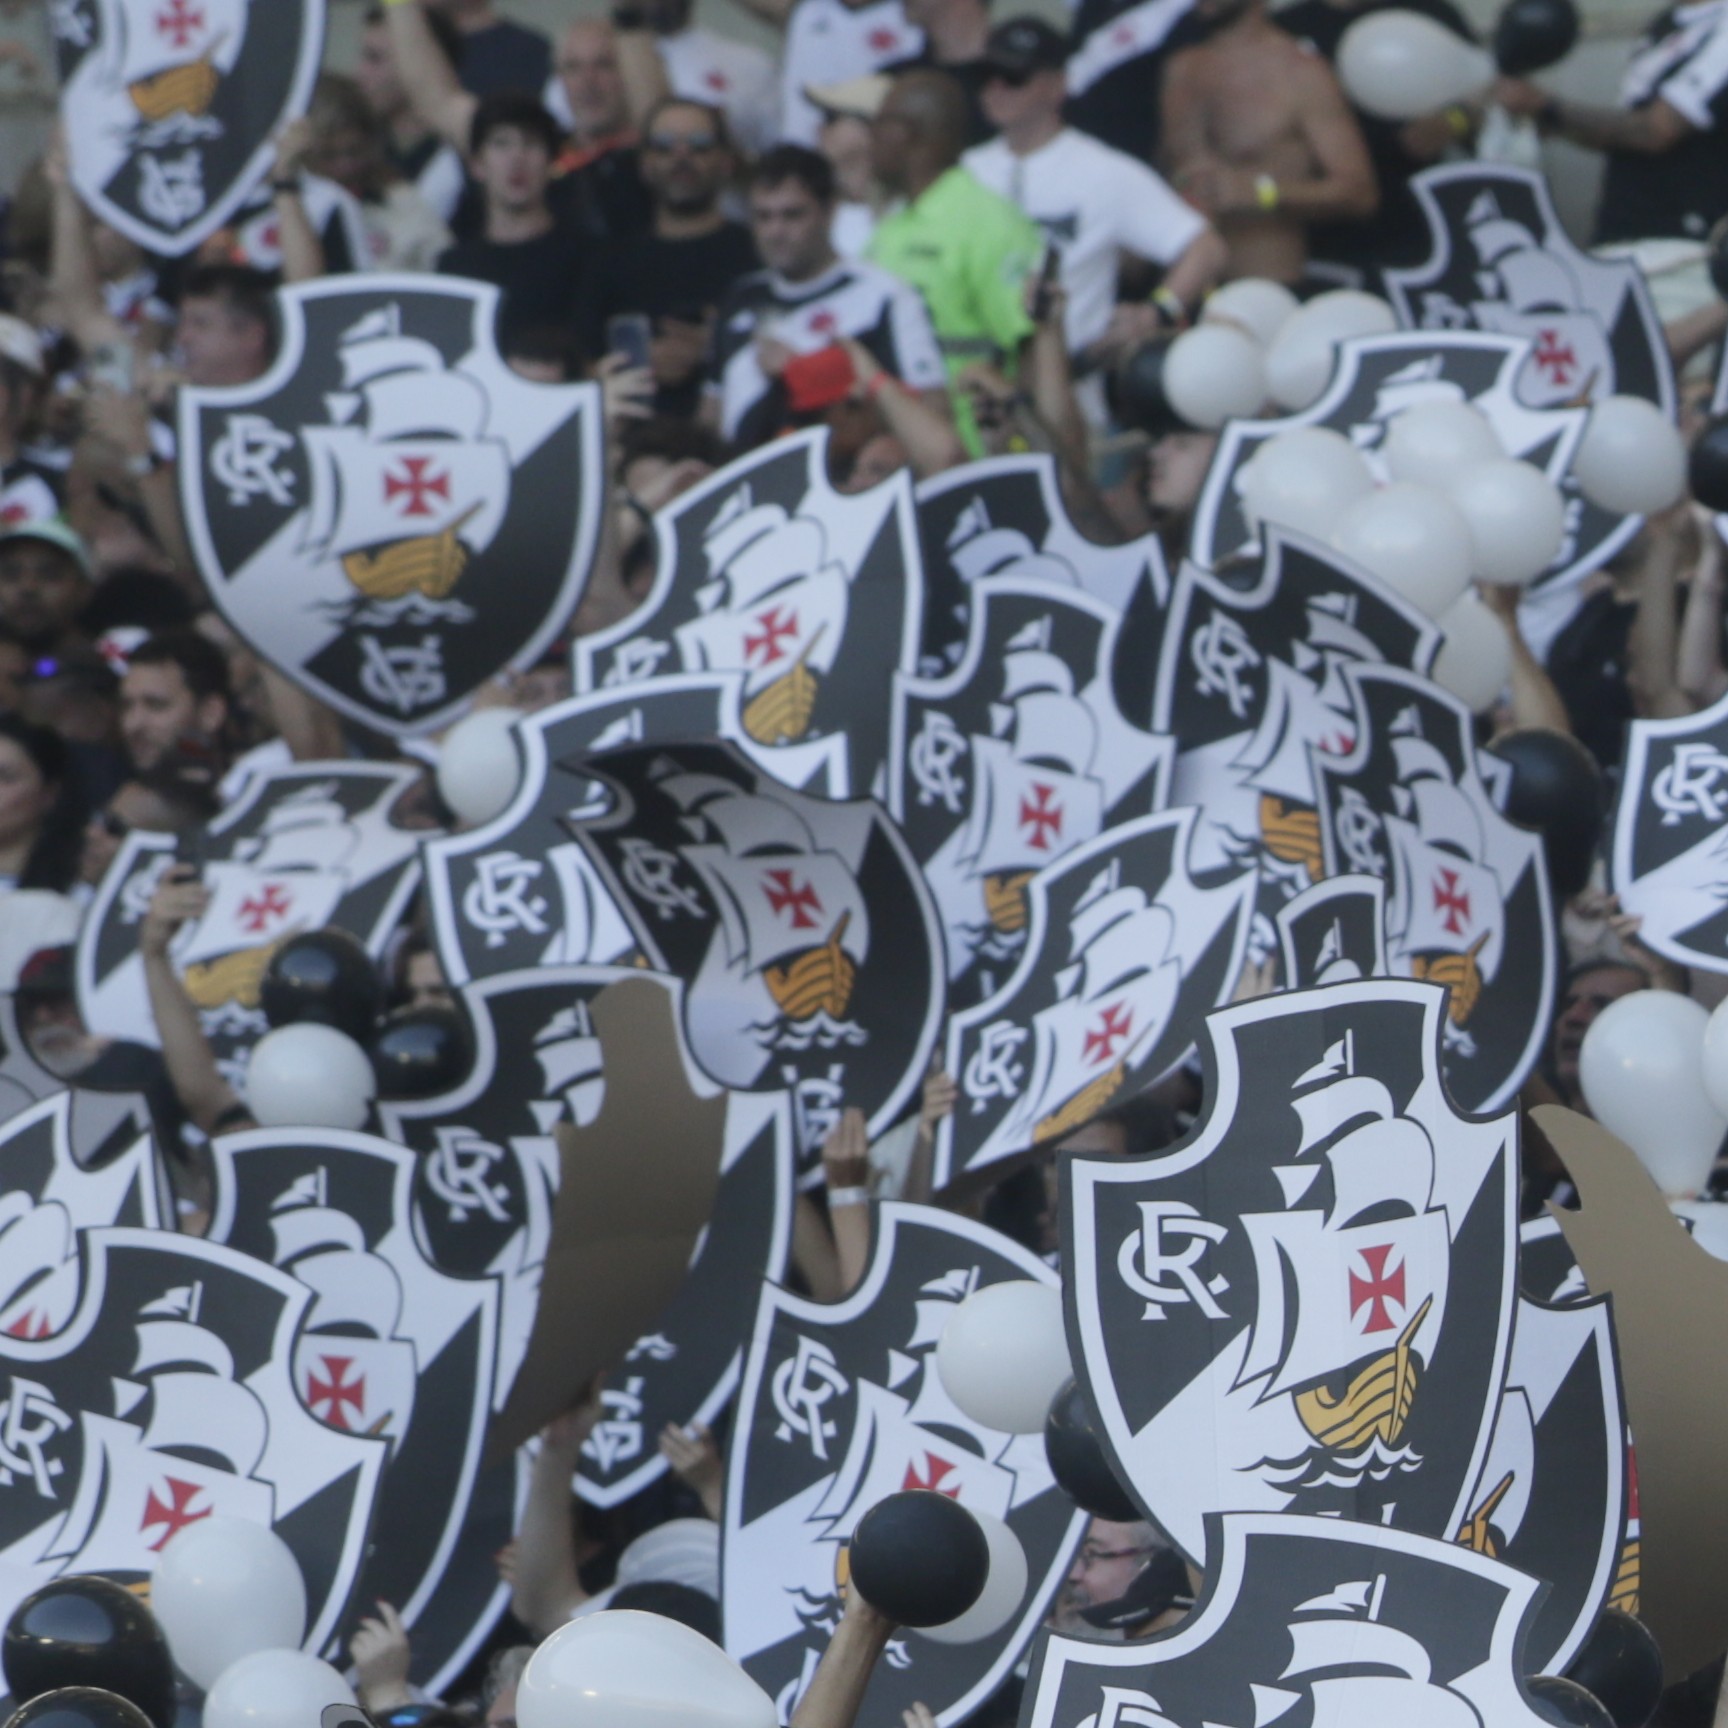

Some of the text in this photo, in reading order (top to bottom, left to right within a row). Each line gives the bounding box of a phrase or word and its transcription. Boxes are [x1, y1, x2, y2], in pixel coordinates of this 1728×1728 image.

[211, 415, 295, 506] CR
[359, 634, 445, 714] VG
[1192, 608, 1260, 718] CR
[911, 709, 969, 812] CR
[464, 851, 546, 946] CR
[620, 839, 706, 919] CR
[964, 1018, 1026, 1113] CR
[425, 1126, 510, 1221] CR
[1117, 1200, 1231, 1321] CR
[770, 1333, 850, 1460] CR
